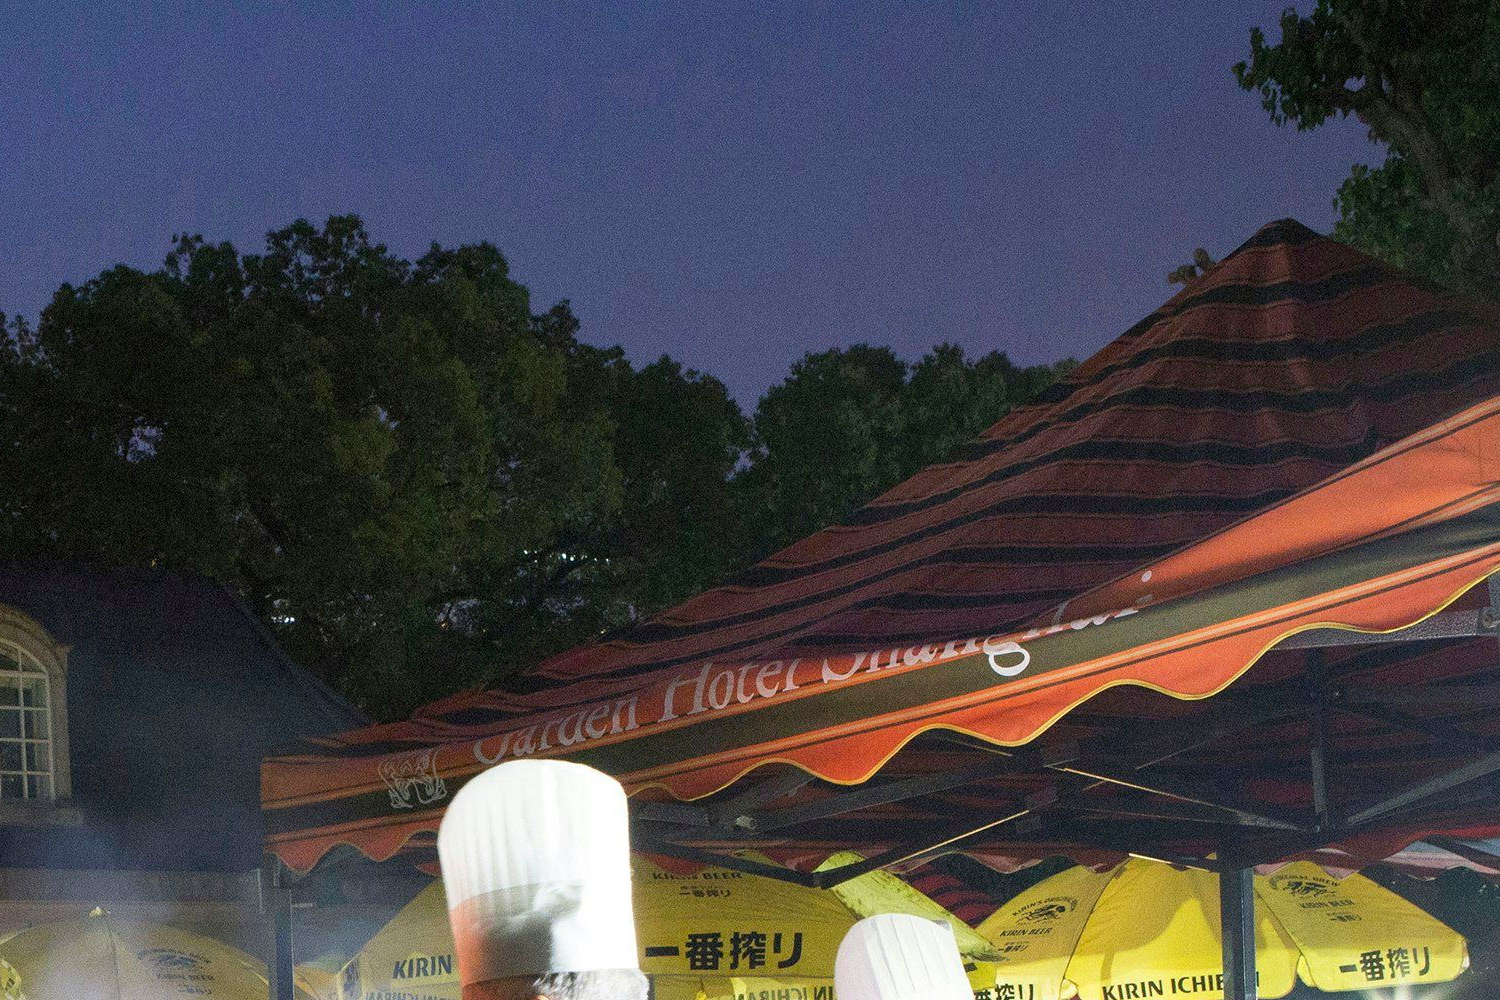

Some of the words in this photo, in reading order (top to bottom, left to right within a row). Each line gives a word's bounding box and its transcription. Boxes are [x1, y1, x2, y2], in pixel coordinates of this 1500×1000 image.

[657, 657, 801, 723] Hotel
[999, 928, 1028, 938] KIRIN
[1027, 926, 1053, 936] BEER
[645, 931, 803, 971] 一番搾り
[1339, 946, 1430, 981] 一番搾り
[392, 954, 453, 980] KIRIN
[1171, 971, 1260, 994] ICHIB
